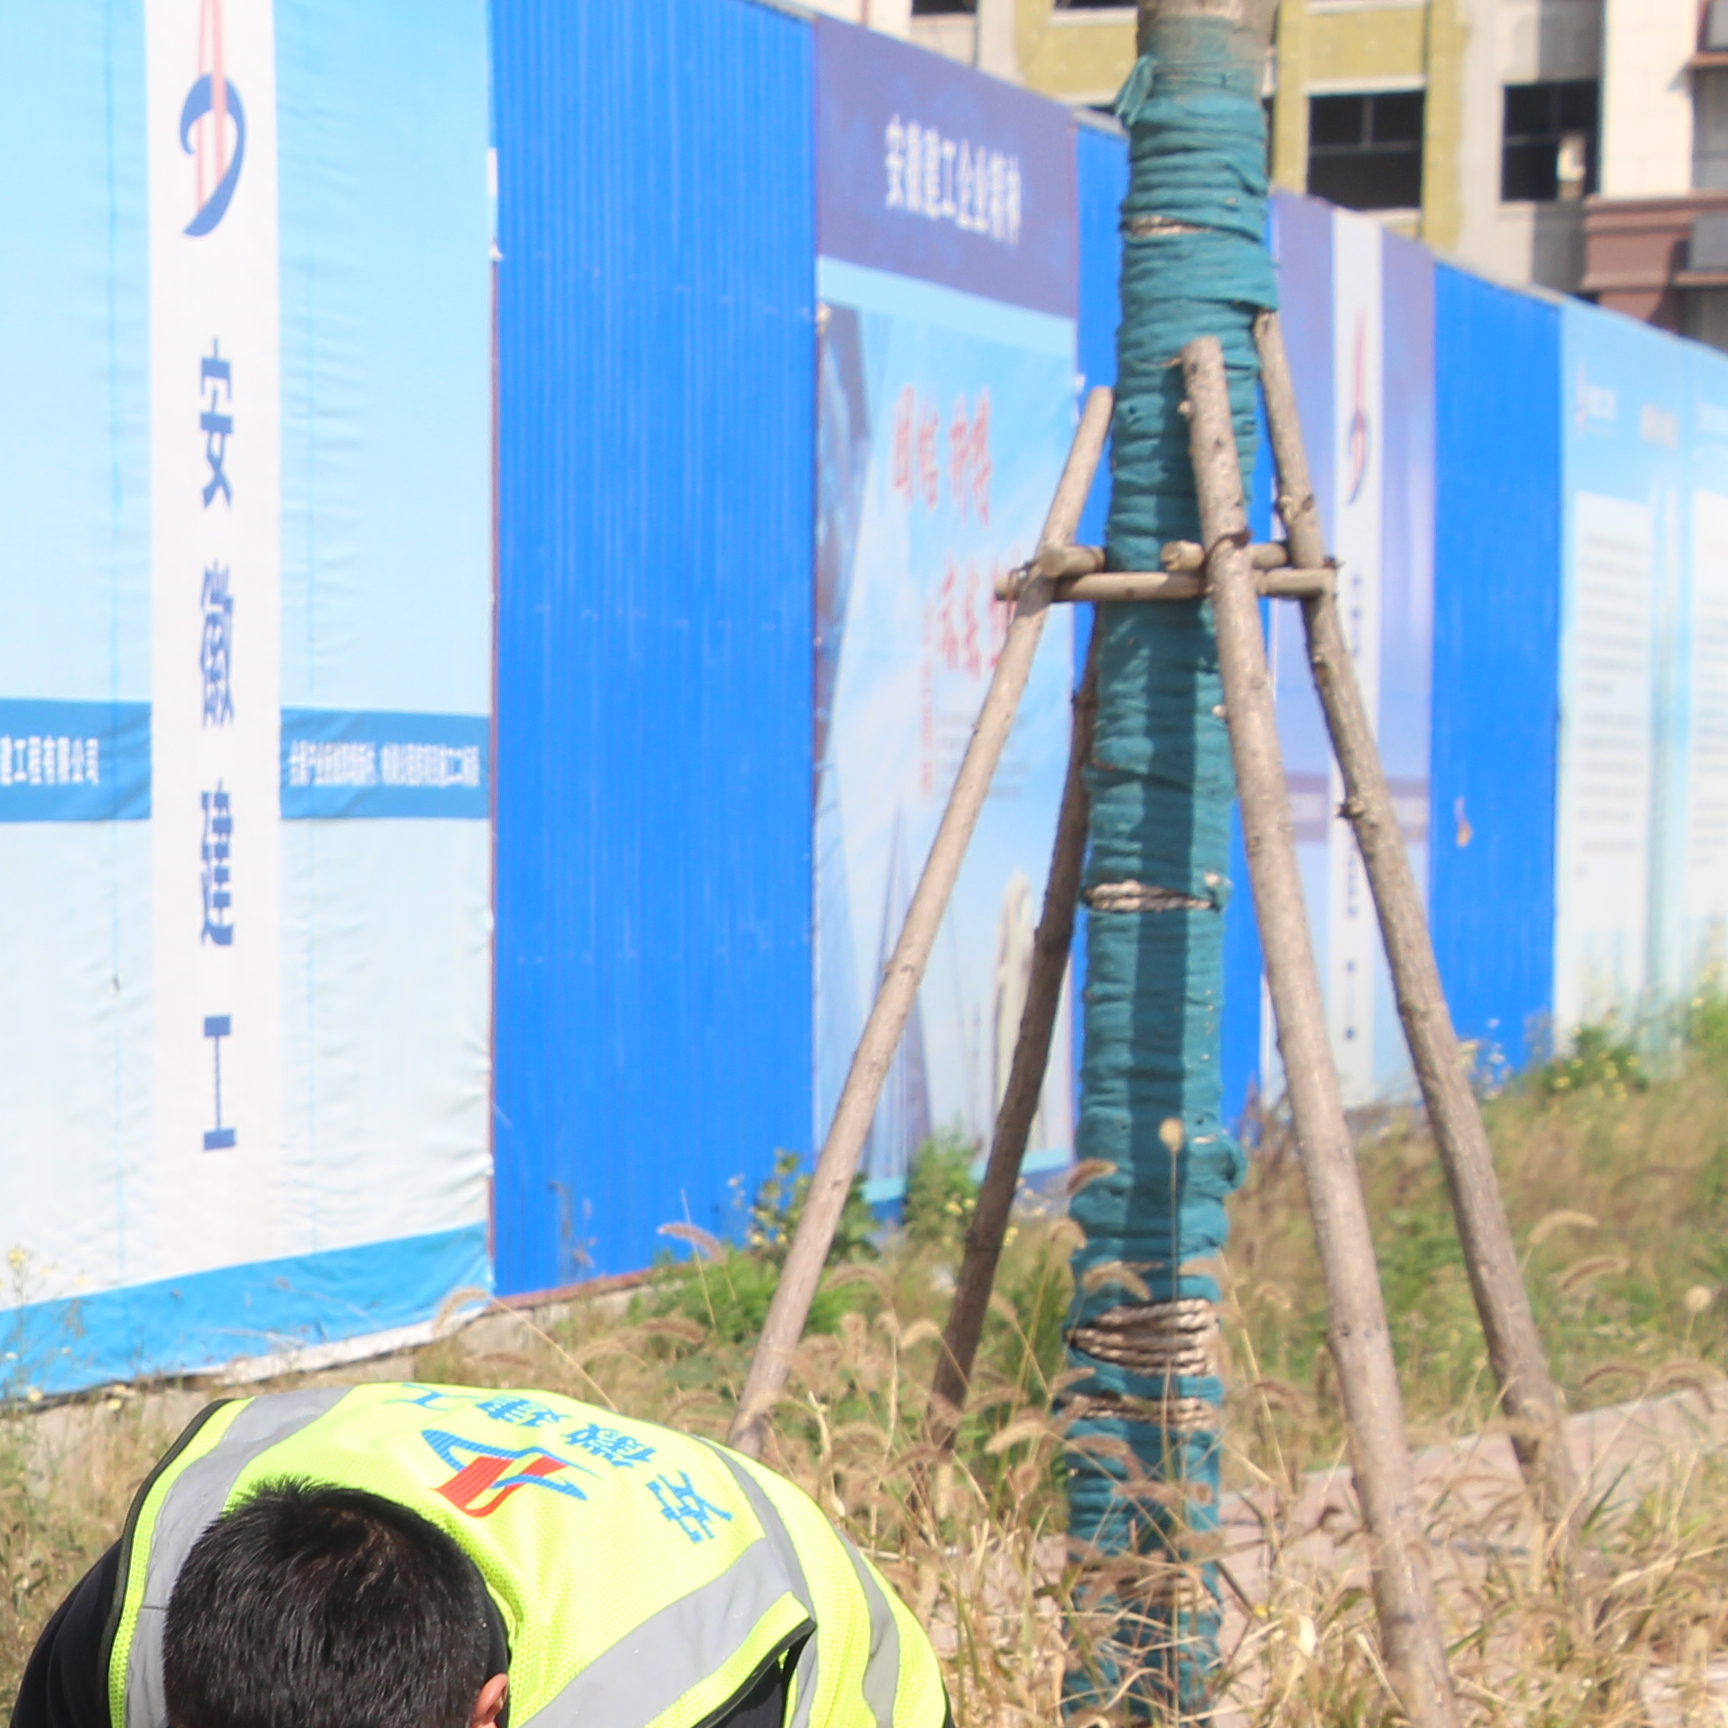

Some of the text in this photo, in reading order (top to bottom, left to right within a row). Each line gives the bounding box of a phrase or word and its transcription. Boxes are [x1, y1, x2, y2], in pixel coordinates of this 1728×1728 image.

[199, 337, 236, 1151] 安徽建工
[382, 1382, 734, 1545] 安徽建工
